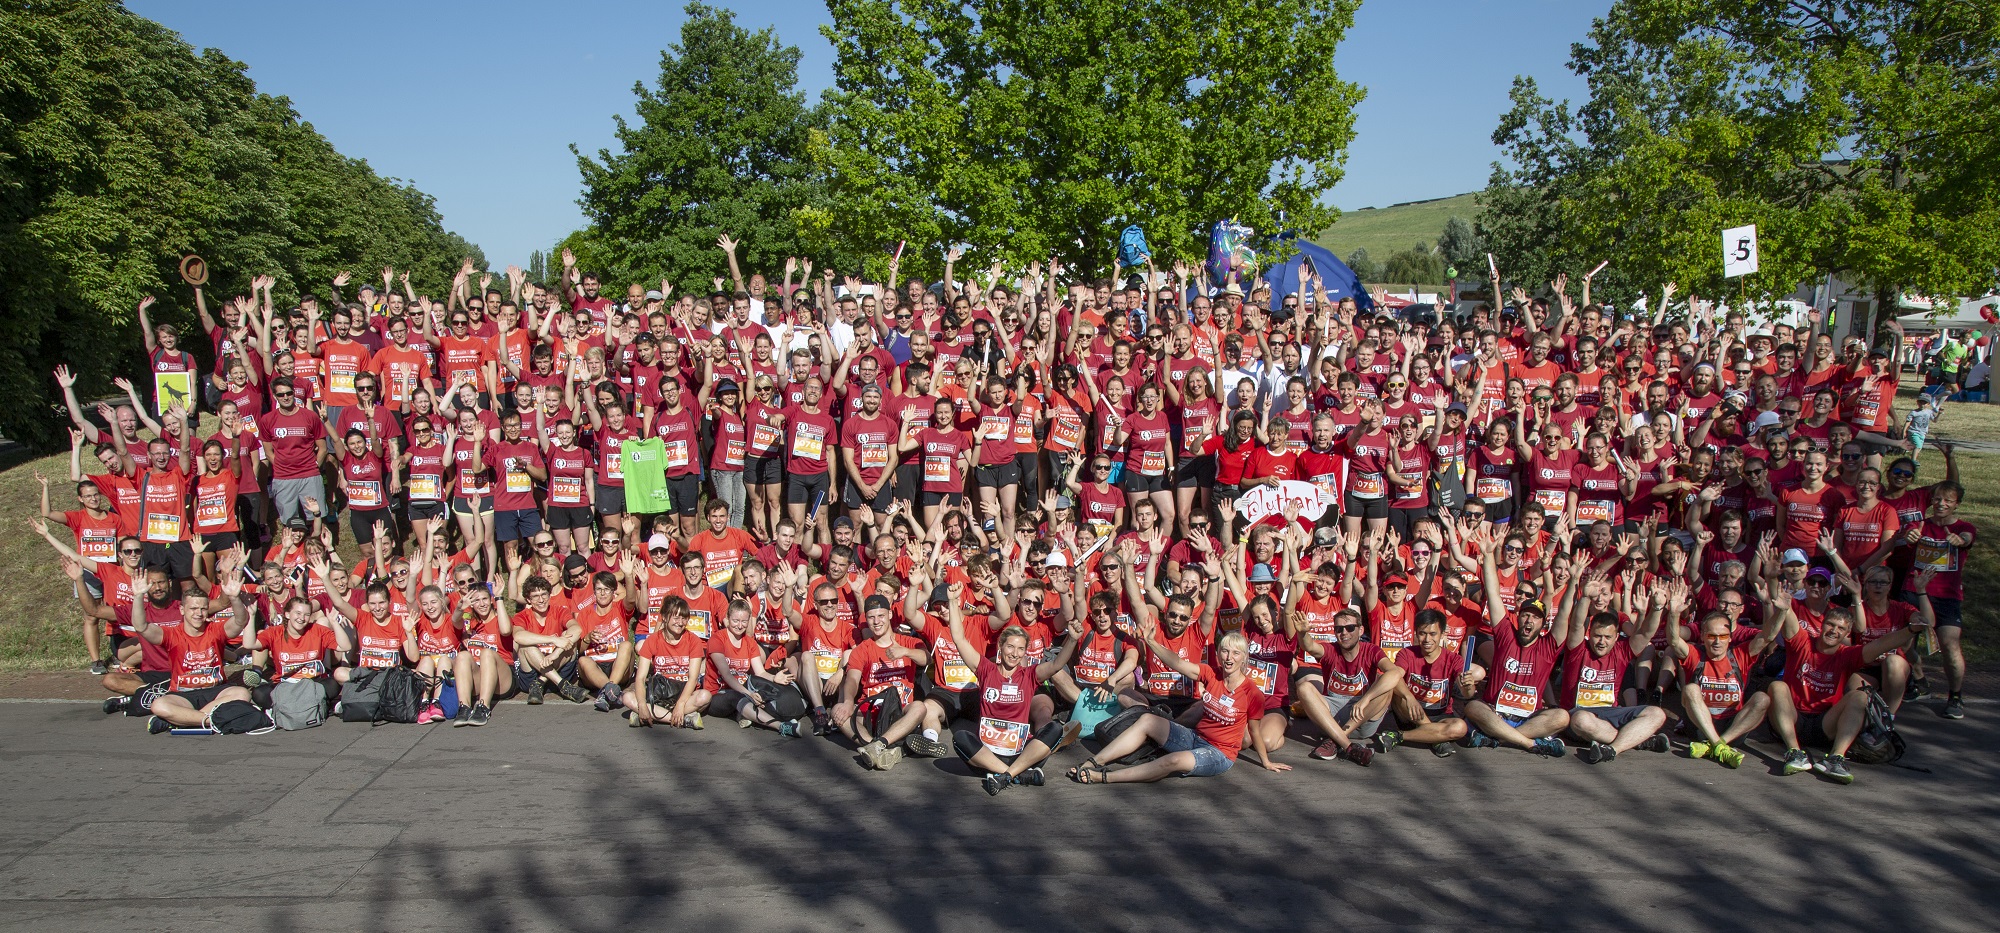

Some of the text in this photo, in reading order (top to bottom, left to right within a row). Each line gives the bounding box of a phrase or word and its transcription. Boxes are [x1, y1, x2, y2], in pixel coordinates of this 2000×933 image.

[1736, 239, 1751, 261] 5
[201, 507, 226, 516] 1091
[153, 522, 178, 531] 1091
[88, 543, 114, 551] 1091
[950, 668, 973, 676] 038
[1080, 668, 1107, 678] 0386
[1246, 668, 1266, 680] 794
[186, 676, 212, 684] 1090
[1154, 682, 1183, 690] 0386
[1333, 680, 1363, 691] 0794
[1412, 685, 1441, 698] 0794
[1505, 693, 1535, 705] 0780
[1584, 693, 1612, 701] 0780
[1708, 692, 1739, 701] 1088
[985, 730, 1017, 742] 0770
